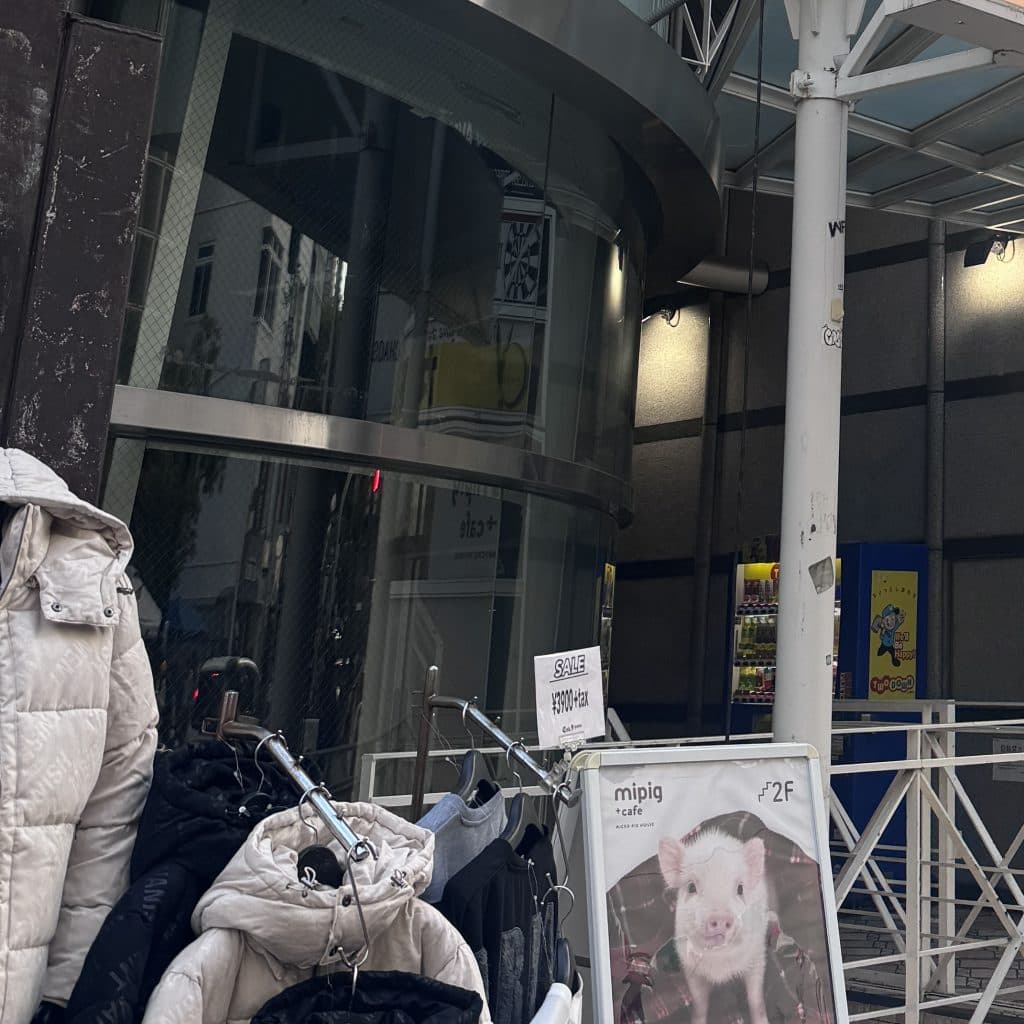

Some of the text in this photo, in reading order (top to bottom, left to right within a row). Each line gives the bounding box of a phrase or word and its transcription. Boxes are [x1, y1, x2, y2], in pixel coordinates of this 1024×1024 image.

[554, 655, 585, 678] SALE
[615, 781, 794, 803] mipig 2F
